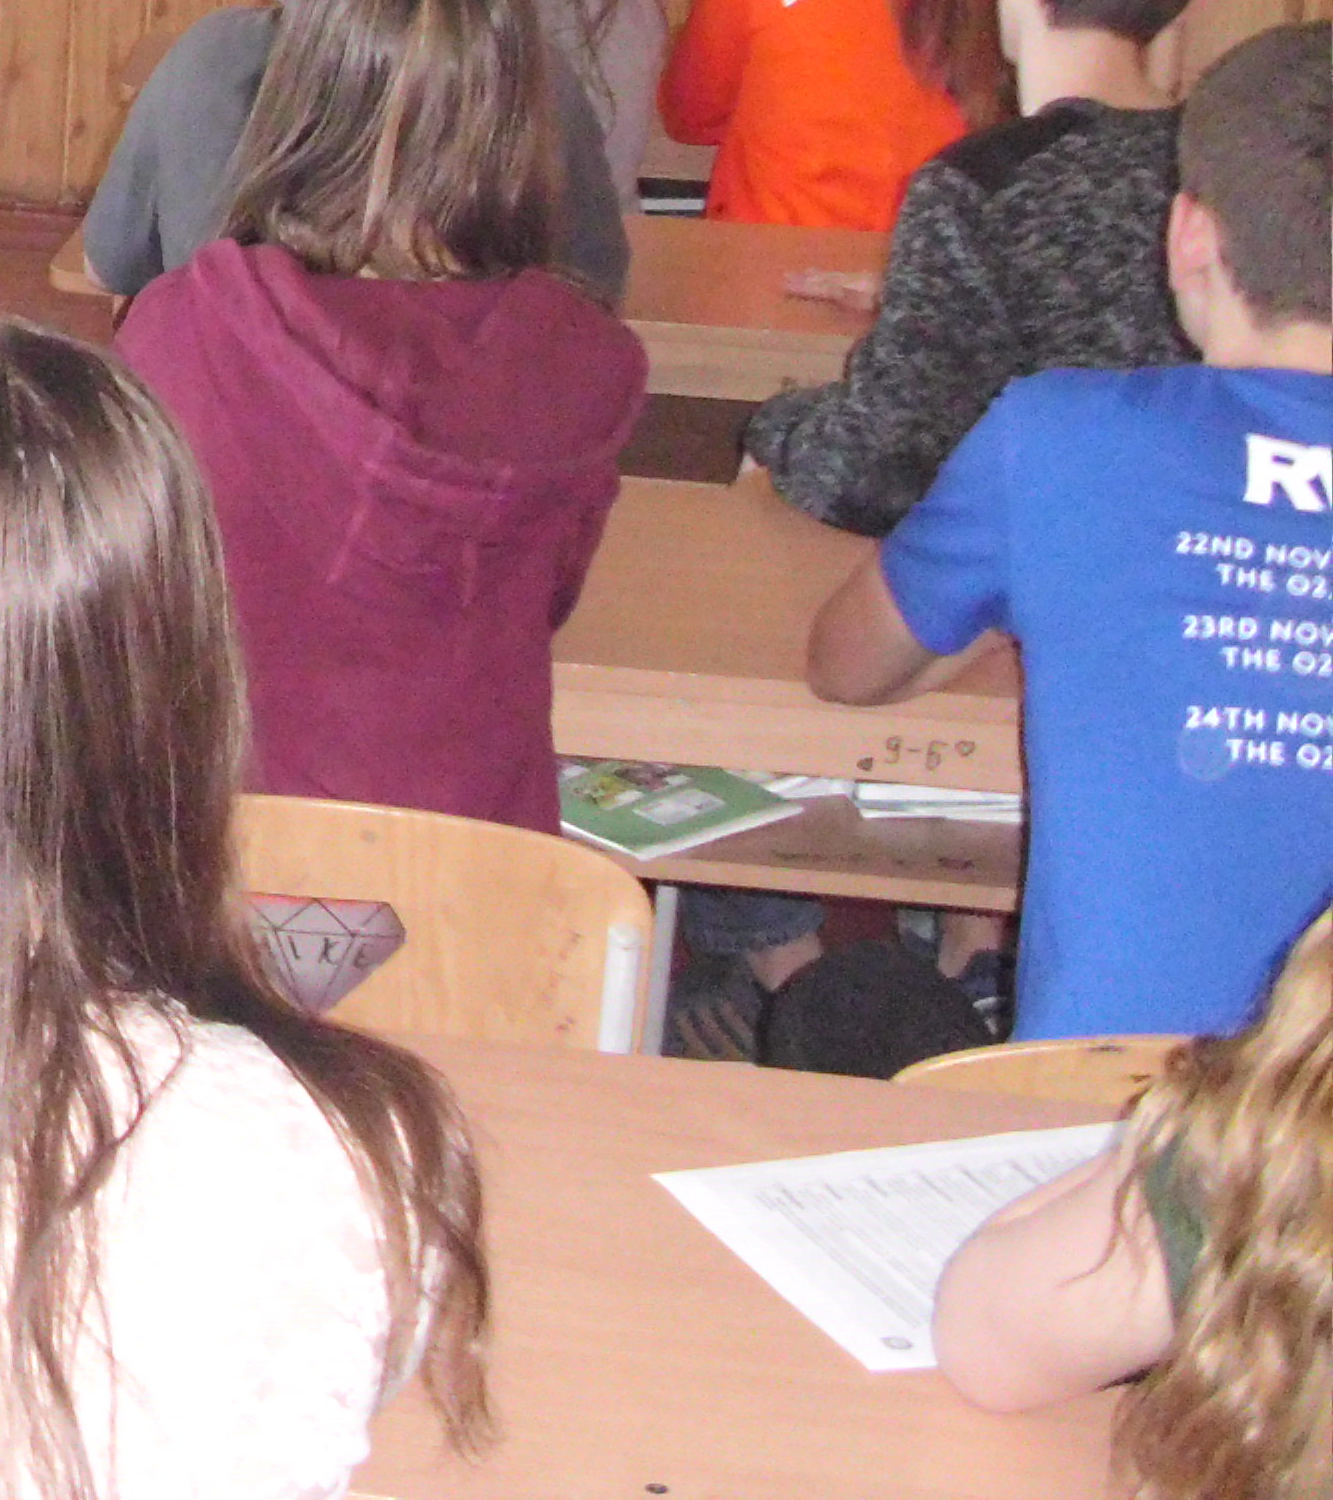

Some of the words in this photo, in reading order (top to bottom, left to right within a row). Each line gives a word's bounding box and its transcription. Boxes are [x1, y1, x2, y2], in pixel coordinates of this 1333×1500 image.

[1176, 530, 1254, 560] 22ND
[1216, 562, 1276, 593] THE
[1183, 614, 1258, 640] 23RD
[1220, 646, 1281, 672] THE
[1184, 704, 1265, 734] 24TH
[1225, 738, 1285, 766] THE
